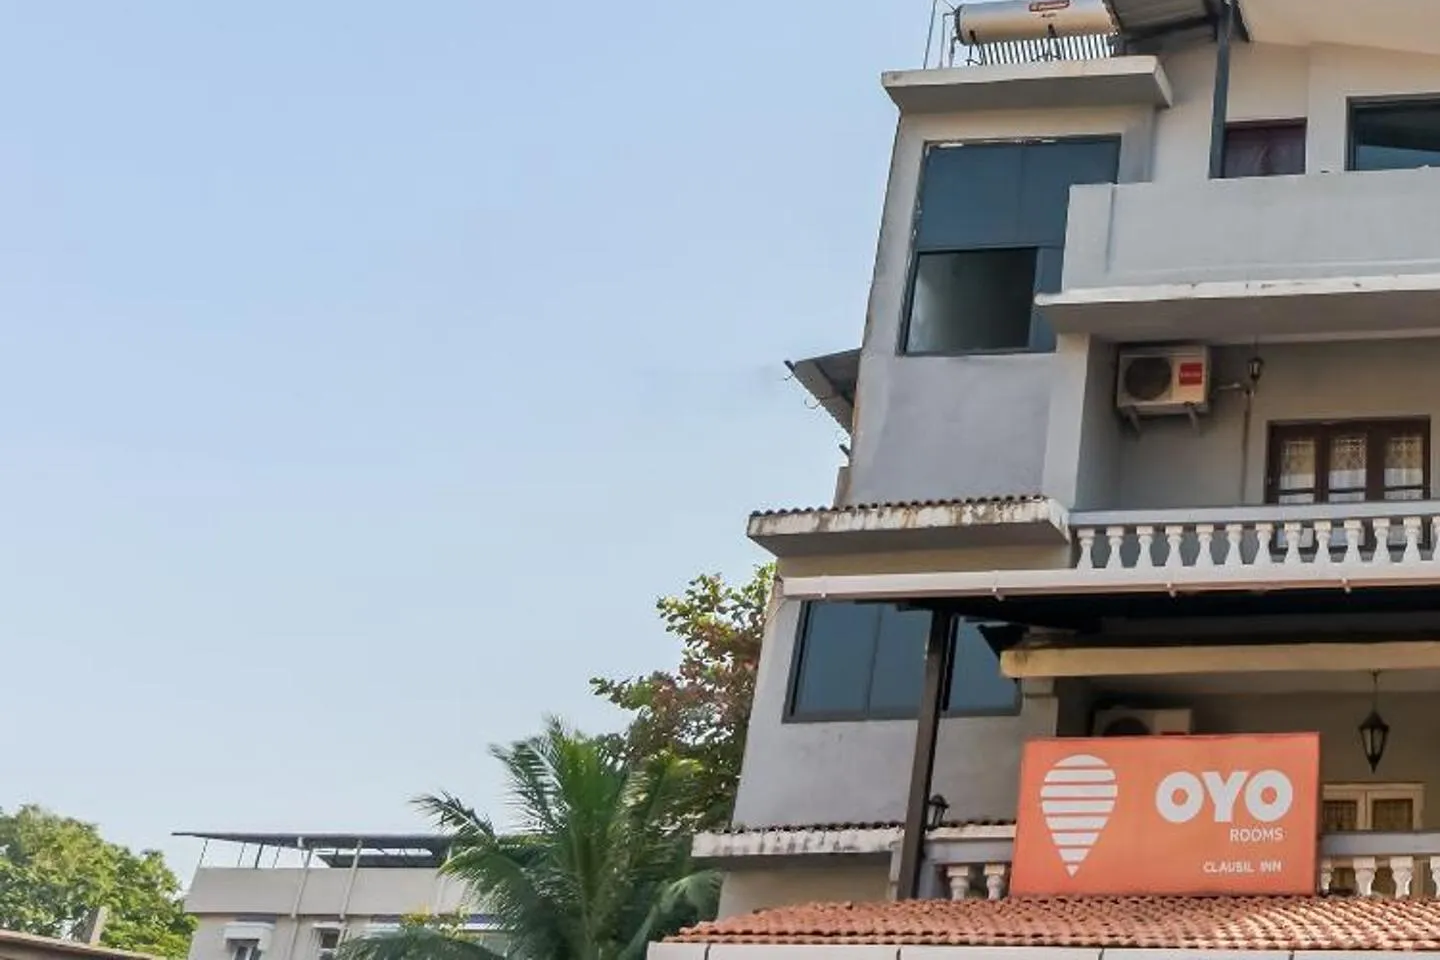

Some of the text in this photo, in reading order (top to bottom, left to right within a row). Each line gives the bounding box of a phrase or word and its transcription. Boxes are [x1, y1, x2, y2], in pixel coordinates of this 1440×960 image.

[1155, 769, 1293, 824] OYO
[1229, 826, 1285, 842] ROOMS
[1260, 859, 1283, 873] INN
